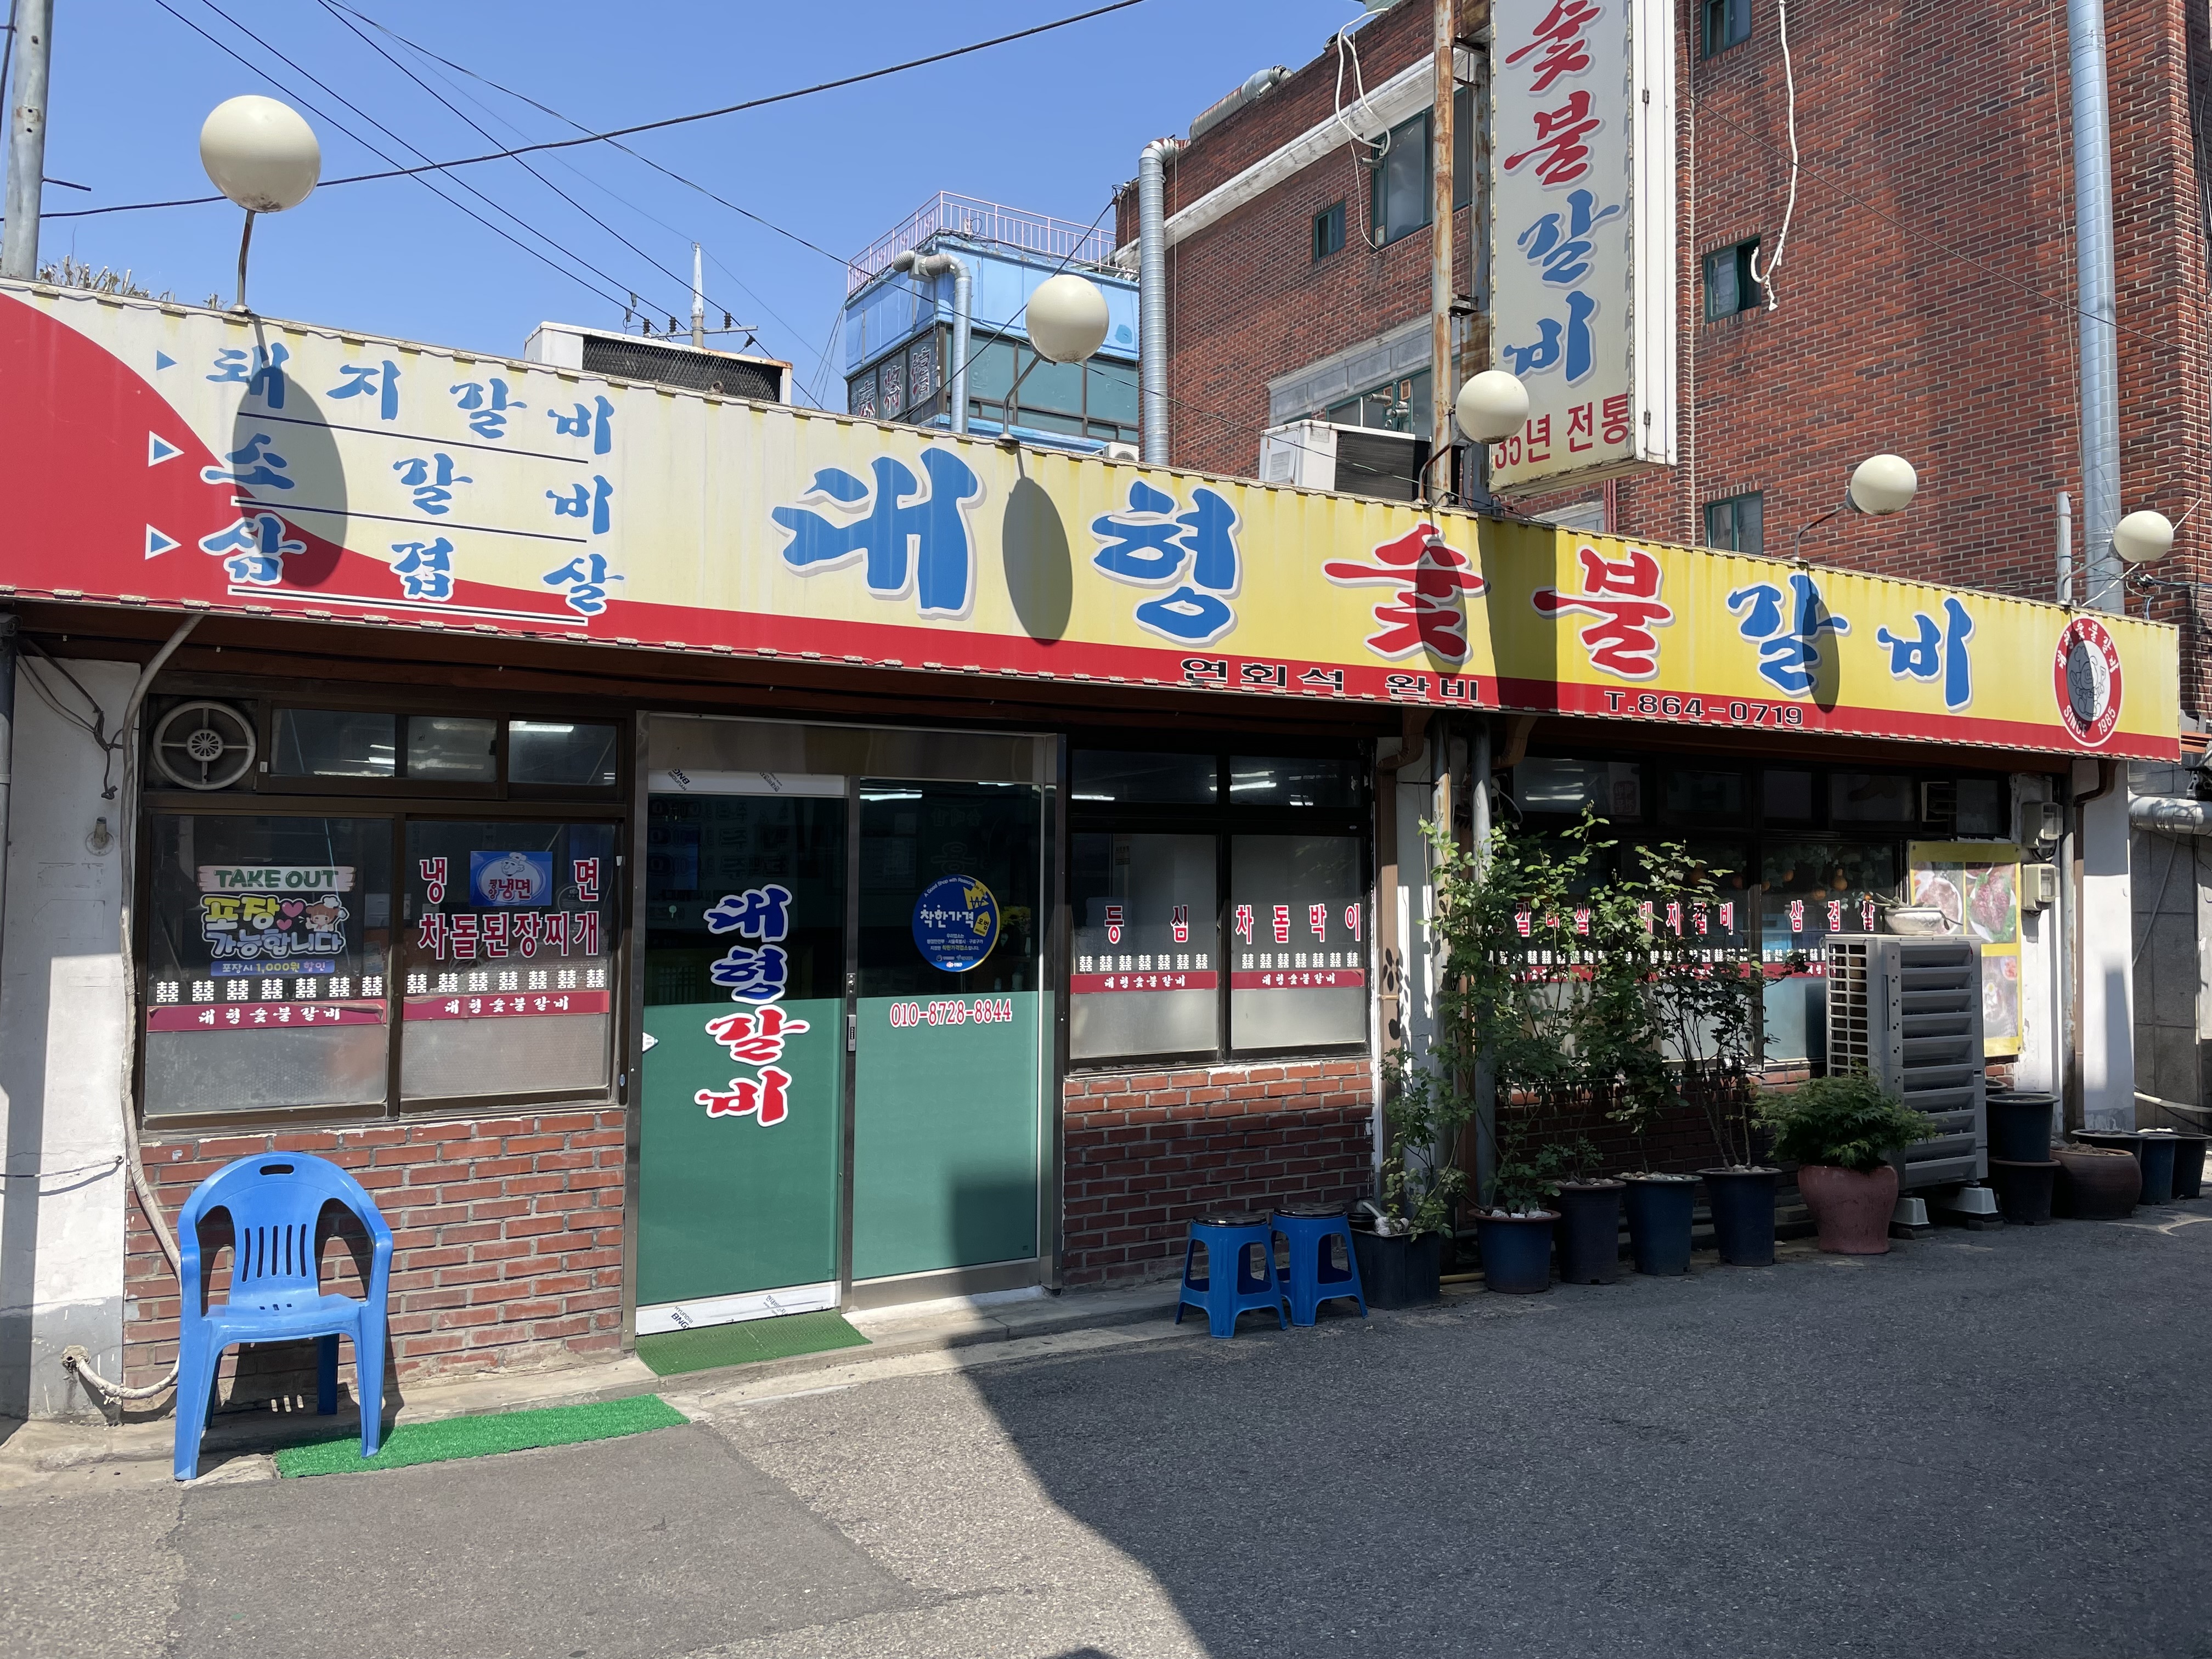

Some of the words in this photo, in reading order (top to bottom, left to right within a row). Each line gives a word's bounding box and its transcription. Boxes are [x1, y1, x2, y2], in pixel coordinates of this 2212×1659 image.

[206, 342, 614, 455] 돼지갈비
[1567, 393, 1629, 453] 전통
[201, 432, 613, 535] 소갈비
[199, 512, 624, 616] 삼겹살
[1181, 657, 1345, 693] 연회석
[1385, 673, 1480, 702] 완비
[1605, 690, 1803, 727] T.864-0719
[2064, 704, 2086, 738] SINCE
[2097, 706, 2117, 735] 1985
[214, 869, 281, 888] TAKE
[285, 870, 338, 888] OUT
[203, 895, 280, 930] 포장
[920, 904, 974, 928] 착한가격
[205, 929, 345, 956] 가능합니다
[222, 963, 253, 974] 포장시
[256, 962, 300, 974] 1,000원
[303, 961, 326, 972] 할인
[694, 883, 811, 1127] 대형갈비
[890, 998, 1013, 1027] 010-8728-8844
